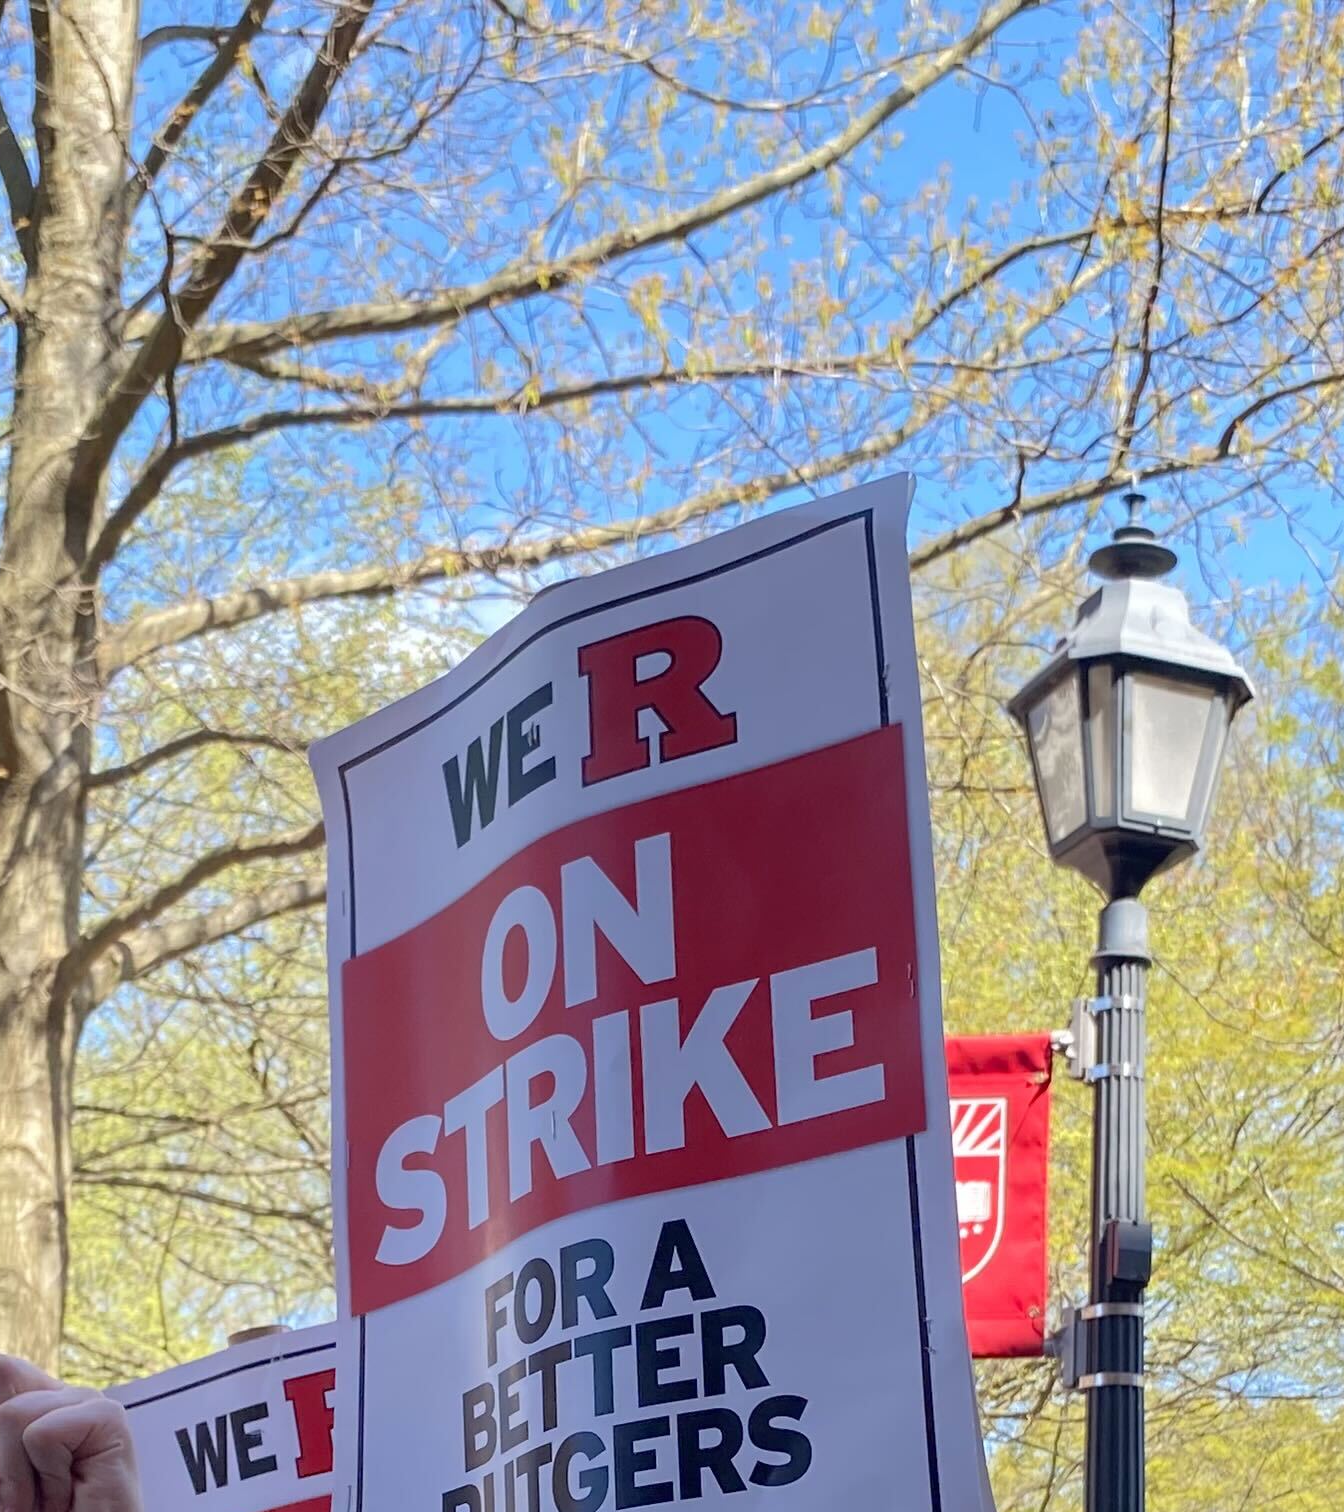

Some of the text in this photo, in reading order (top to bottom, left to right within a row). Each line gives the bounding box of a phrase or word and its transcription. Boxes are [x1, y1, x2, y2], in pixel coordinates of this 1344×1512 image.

[442, 614, 738, 850] WE R
[481, 832, 676, 1041] ON
[374, 946, 886, 1266] STRIKE
[484, 1218, 717, 1368] FOR A
[174, 1401, 278, 1496] WE
[462, 1305, 771, 1473] BETTER
